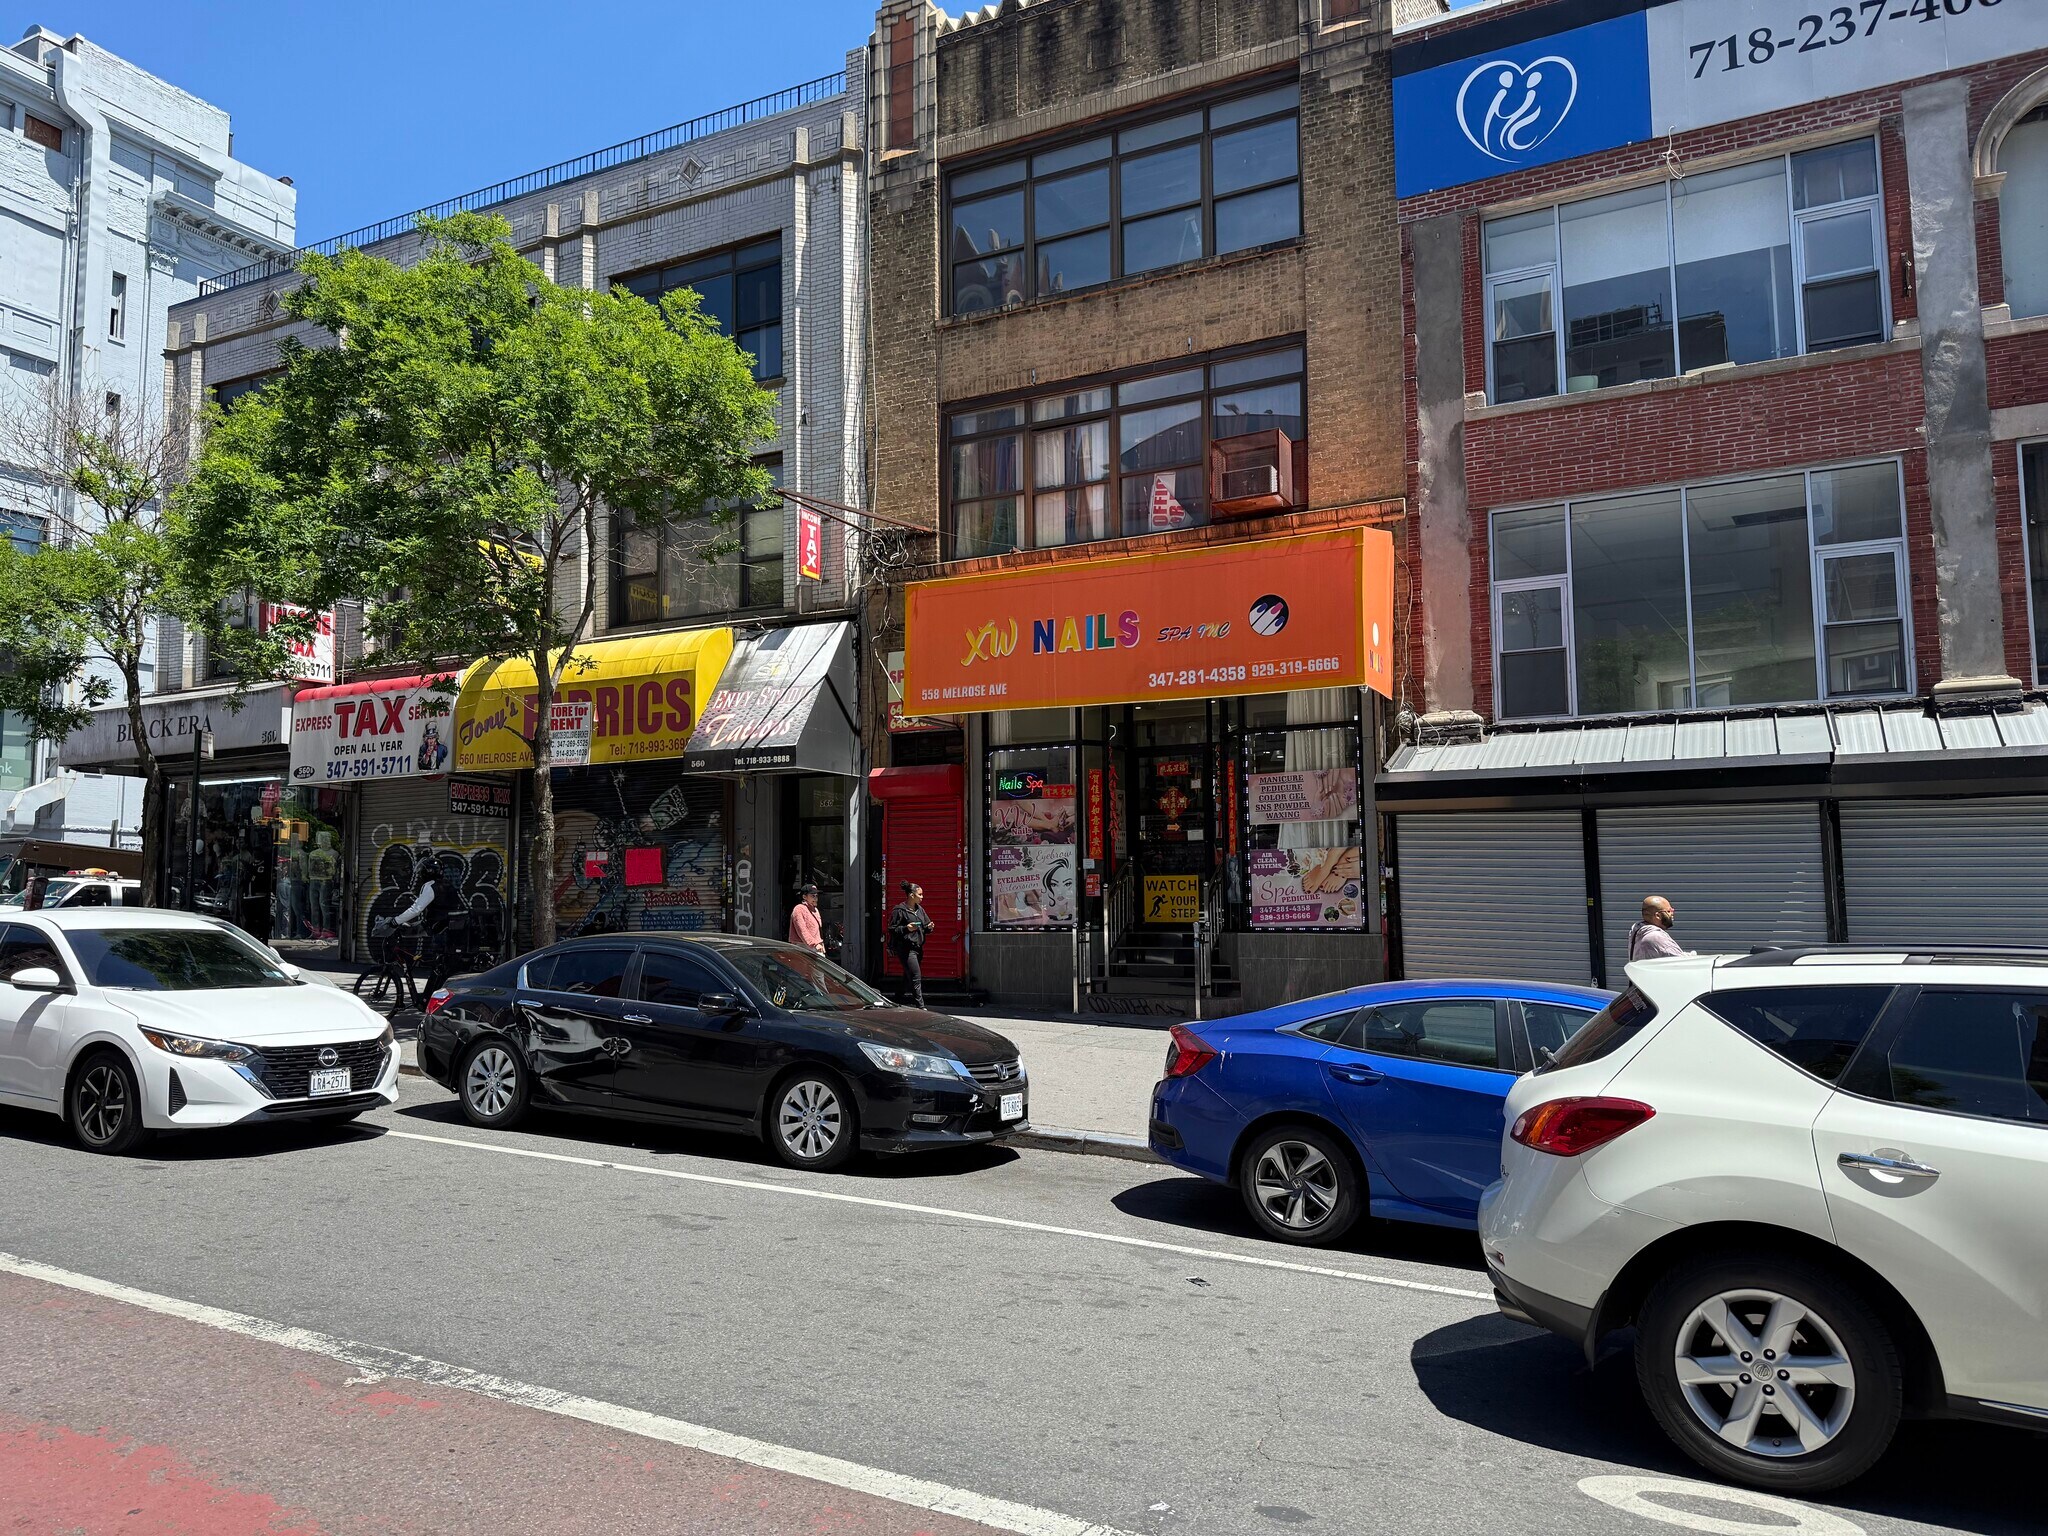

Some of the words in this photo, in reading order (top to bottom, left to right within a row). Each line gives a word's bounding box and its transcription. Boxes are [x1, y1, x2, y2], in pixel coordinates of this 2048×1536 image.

[1689, 0, 2001, 79] 718-237-4
[801, 509, 821, 526] INCOME
[806, 524, 817, 568] TAX
[961, 616, 1018, 667] XW
[1033, 610, 1140, 655] NAILS
[1157, 625, 1192, 643] SPA
[1148, 665, 1246, 688] 347-281-4358
[1251, 656, 1339, 677] 929-319-6666
[922, 689, 940, 700] 558
[942, 685, 986, 699] MELROSE
[988, 683, 1007, 696] AVE
[295, 715, 333, 732] EXPRESS
[334, 695, 406, 739] TAX
[459, 696, 519, 746] Tony's
[523, 678, 691, 741] FRICS
[551, 706, 573, 717] TORE
[574, 705, 589, 716] for
[116, 718, 173, 743] BLCK
[177, 714, 213, 736] ERA
[550, 718, 583, 731] RENT
[334, 744, 357, 756] OPEN
[361, 743, 376, 754] ALL
[380, 740, 403, 752] YEAR
[460, 753, 474, 765] 560
[477, 752, 517, 764] MELROSE
[746, 755, 790, 764] 718-933-9888
[326, 755, 411, 779] 347-591-3711
[999, 777, 1023, 791] Nails
[1026, 775, 1043, 793] Spa
[1259, 774, 1304, 784] MANICURE
[451, 783, 489, 802] EXPRESS
[493, 787, 510, 804] TAX
[1261, 783, 1303, 793] PEDICURE
[1258, 793, 1287, 802] COLOR
[1289, 793, 1306, 801] GEL
[452, 802, 509, 817] 347-591-3711
[1273, 801, 1311, 811] POWDER
[1265, 811, 1300, 820] WAXING
[1011, 827, 1033, 837] Nails
[1035, 848, 1073, 863] Eyebrow
[997, 873, 1041, 885] EYELASHES
[1145, 880, 1197, 891] WATCH
[1260, 880, 1297, 903] Spa
[1281, 893, 1321, 903] PEDICURE
[1170, 896, 1197, 906] YOUR
[1170, 908, 1196, 918] STEP
[1259, 905, 1311, 914] 347-281-4358
